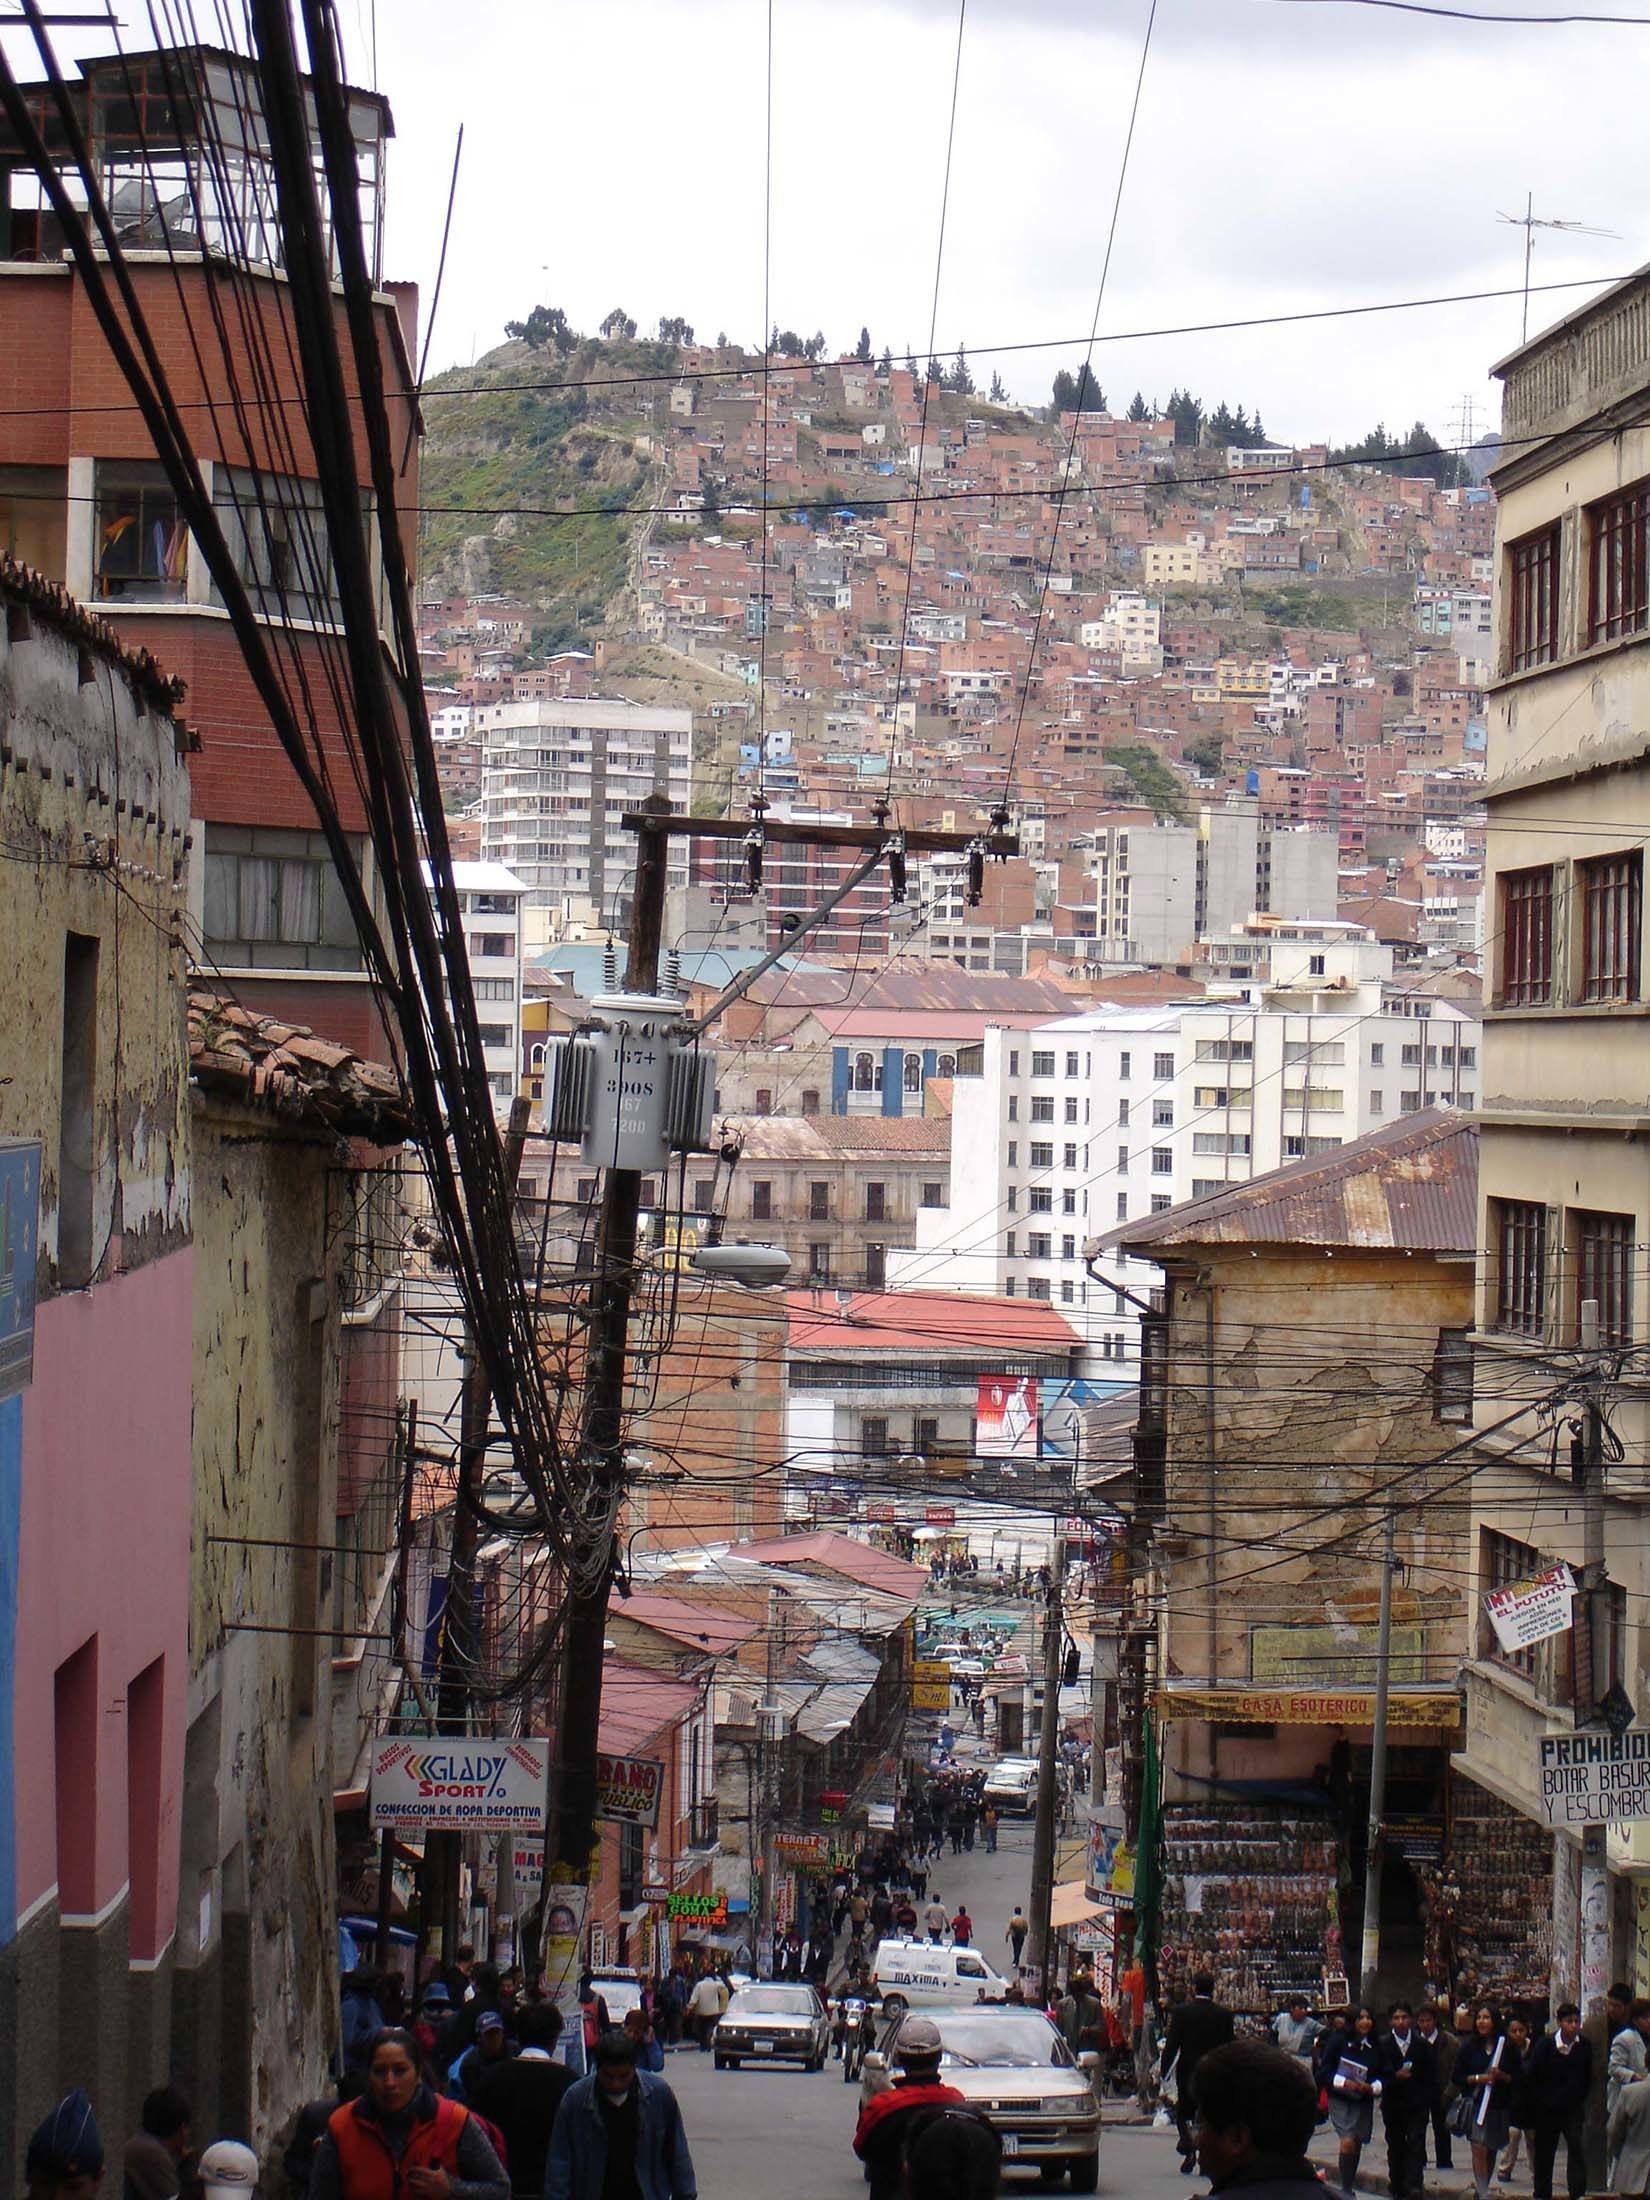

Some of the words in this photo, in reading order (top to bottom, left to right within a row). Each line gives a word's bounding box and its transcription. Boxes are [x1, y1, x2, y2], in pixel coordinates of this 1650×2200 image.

[1496, 1607, 1512, 1618] EL
[1242, 1698, 1282, 1713] CASA
[1290, 1698, 1369, 1713] ESOTERICO
[1541, 1733, 1650, 1767] PROHIBID
[428, 1755, 507, 1797] GLADY
[1543, 1767, 1589, 1796] BOTAR
[418, 1780, 487, 1798] SPORT
[375, 1804, 436, 1816] CONFECCION
[439, 1805, 451, 1816] DE
[455, 1805, 483, 1817] ROPA
[486, 1806, 541, 1817] DEPORTIVA
[1545, 1798, 1554, 1824] Y
[667, 1894, 719, 1908] SELLOS
[670, 1904, 710, 1917] GOMA
